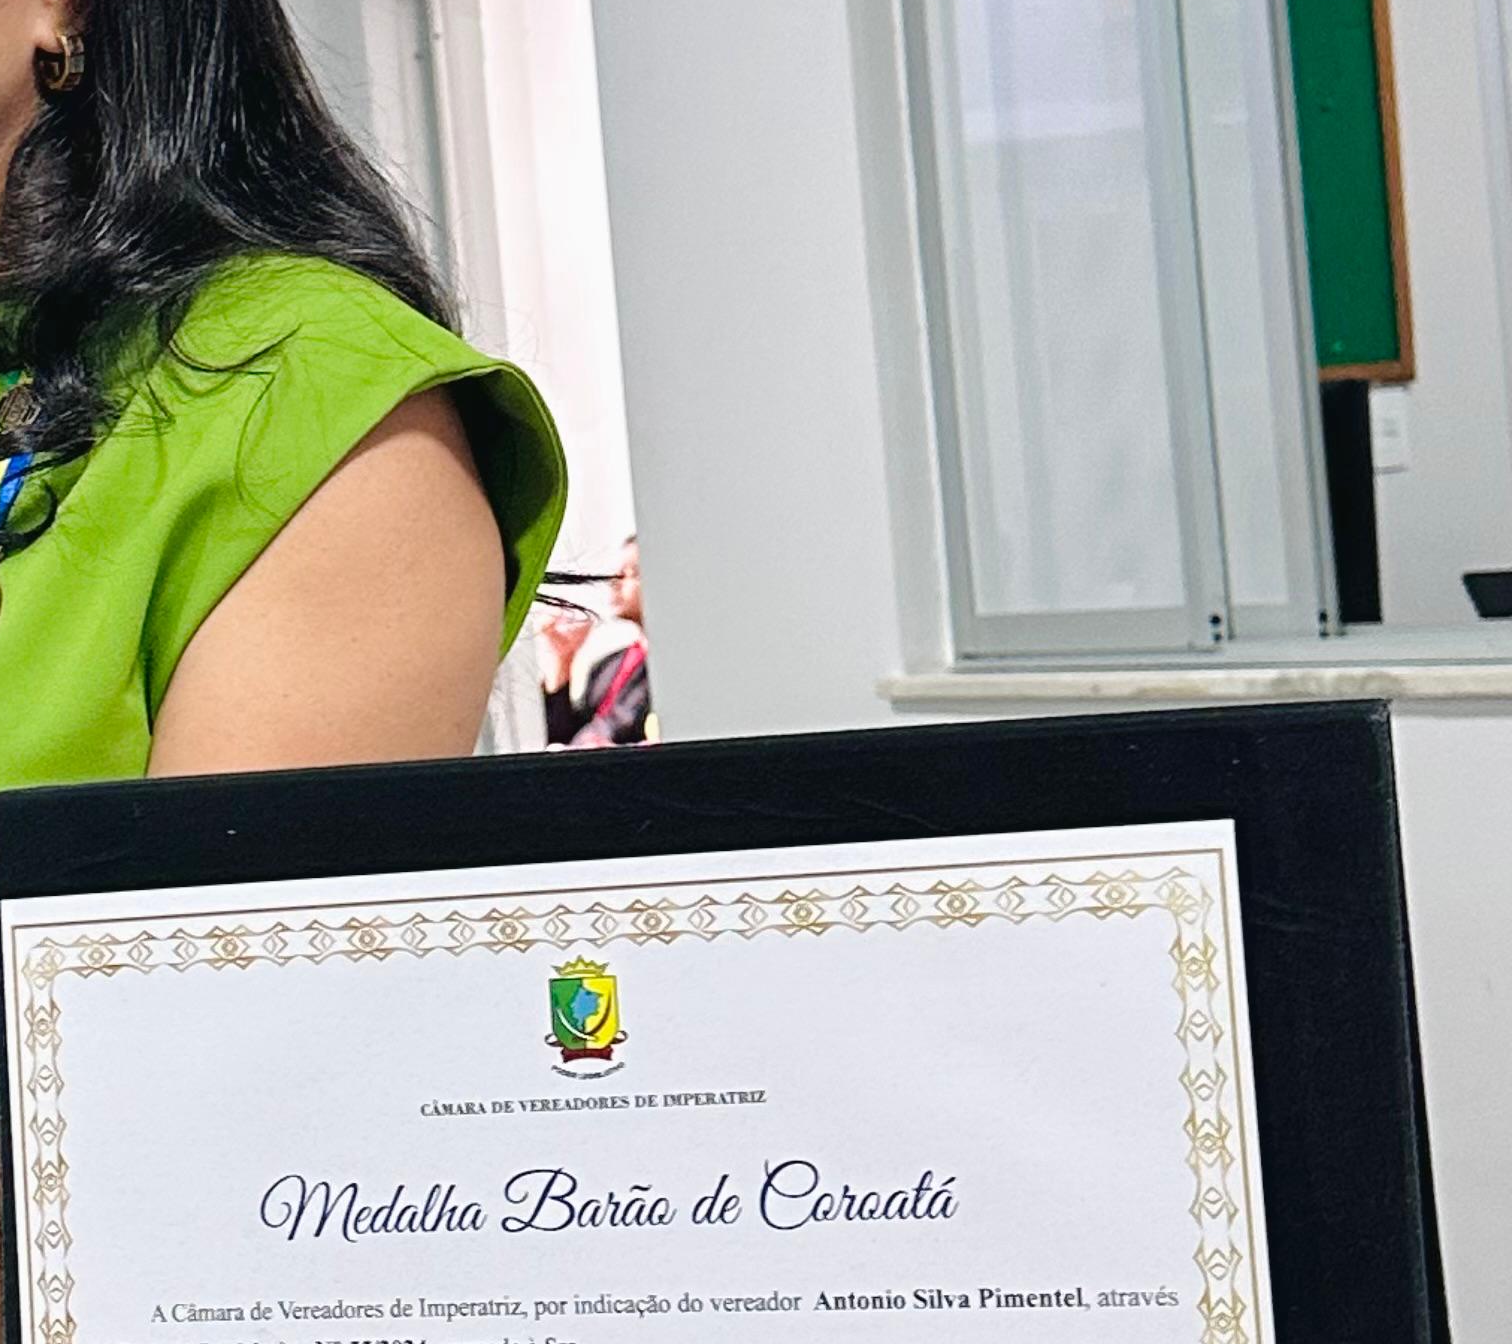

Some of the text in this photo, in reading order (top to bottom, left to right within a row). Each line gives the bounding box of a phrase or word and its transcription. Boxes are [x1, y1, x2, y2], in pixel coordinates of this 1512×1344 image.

[420, 1090, 767, 1117] CÂMARA DE VEREADORES DE IMPERATRIZ
[260, 1159, 959, 1243] Medalha Barão de Coroatá
[151, 1286, 1179, 1323] A Câmara de Vereadores de Imperatriz, por indicação do vereador Antonio Silva Pimentel, através
